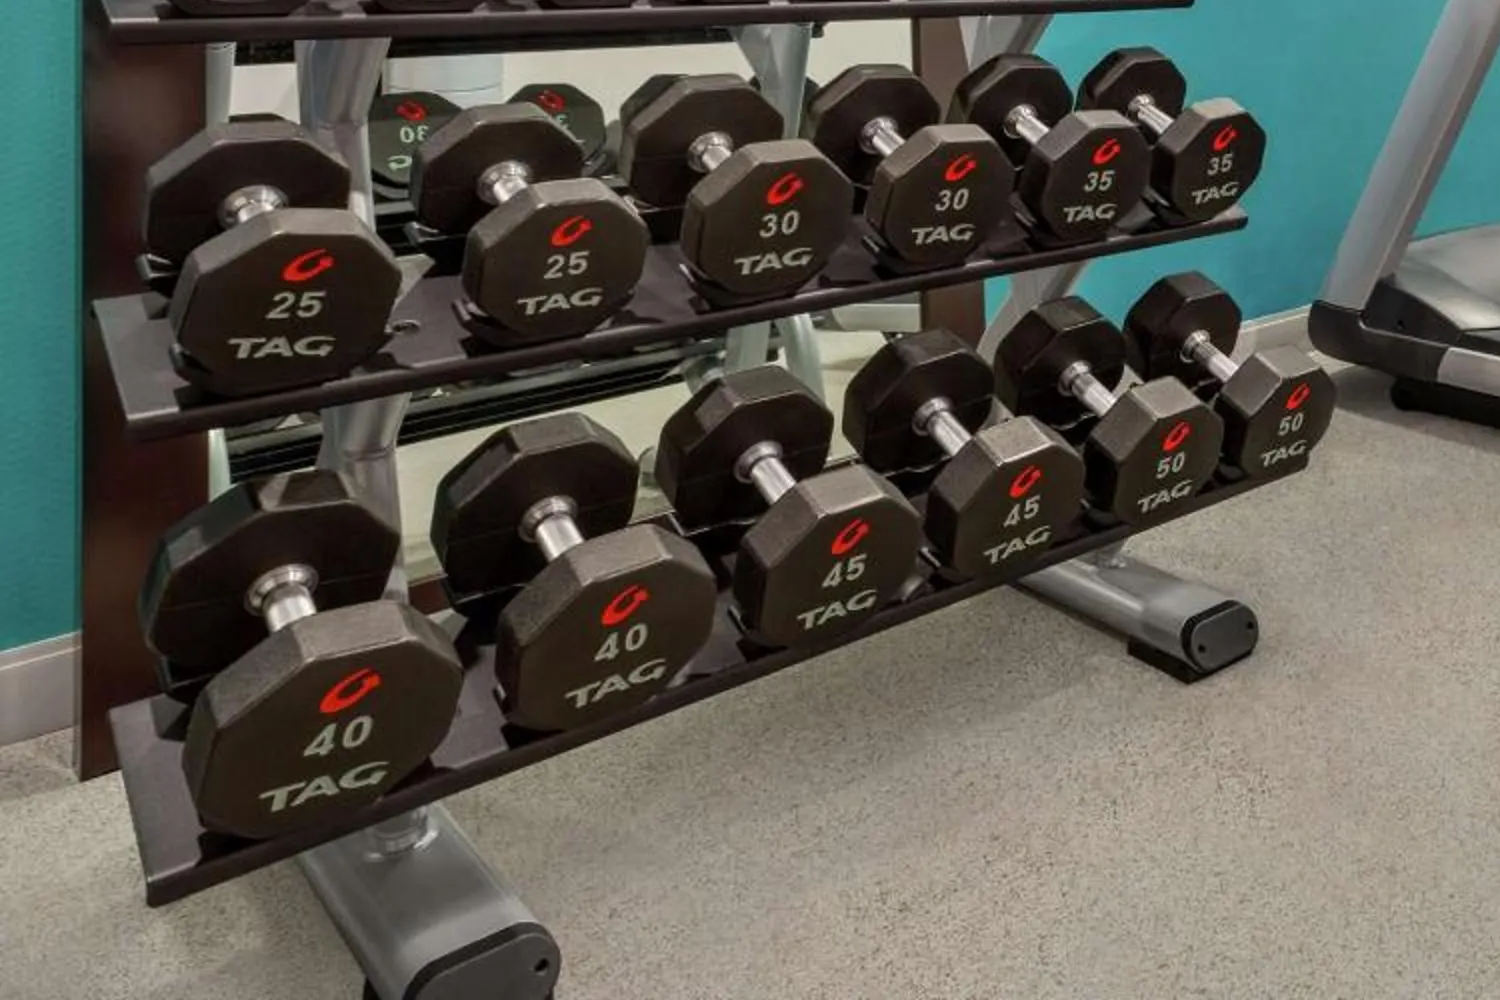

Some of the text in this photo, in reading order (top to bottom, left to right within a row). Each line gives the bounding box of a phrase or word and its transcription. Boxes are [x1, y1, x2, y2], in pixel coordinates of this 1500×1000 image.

[1206, 152, 1234, 177] 35
[1083, 169, 1116, 193] 35
[1191, 181, 1239, 205] TAG
[934, 187, 970, 212] 30
[1063, 202, 1117, 224] TAG
[759, 209, 800, 239] 30
[911, 223, 975, 246] TAG
[543, 250, 590, 280] 25
[733, 247, 812, 276] TAG
[265, 290, 326, 320] 25
[516, 287, 603, 316] TAG
[227, 335, 336, 359] TAG
[1277, 411, 1305, 437] 50
[1155, 450, 1186, 480] 50
[1259, 439, 1308, 467] TAG
[1003, 494, 1041, 528] 45
[1137, 479, 1193, 514] TAG
[982, 525, 1052, 565] TAG
[821, 553, 868, 588] 45
[796, 588, 877, 630] TAG
[594, 623, 649, 663] 40
[565, 658, 667, 709] TAG
[303, 715, 373, 757] 40
[258, 760, 389, 813] TAG
